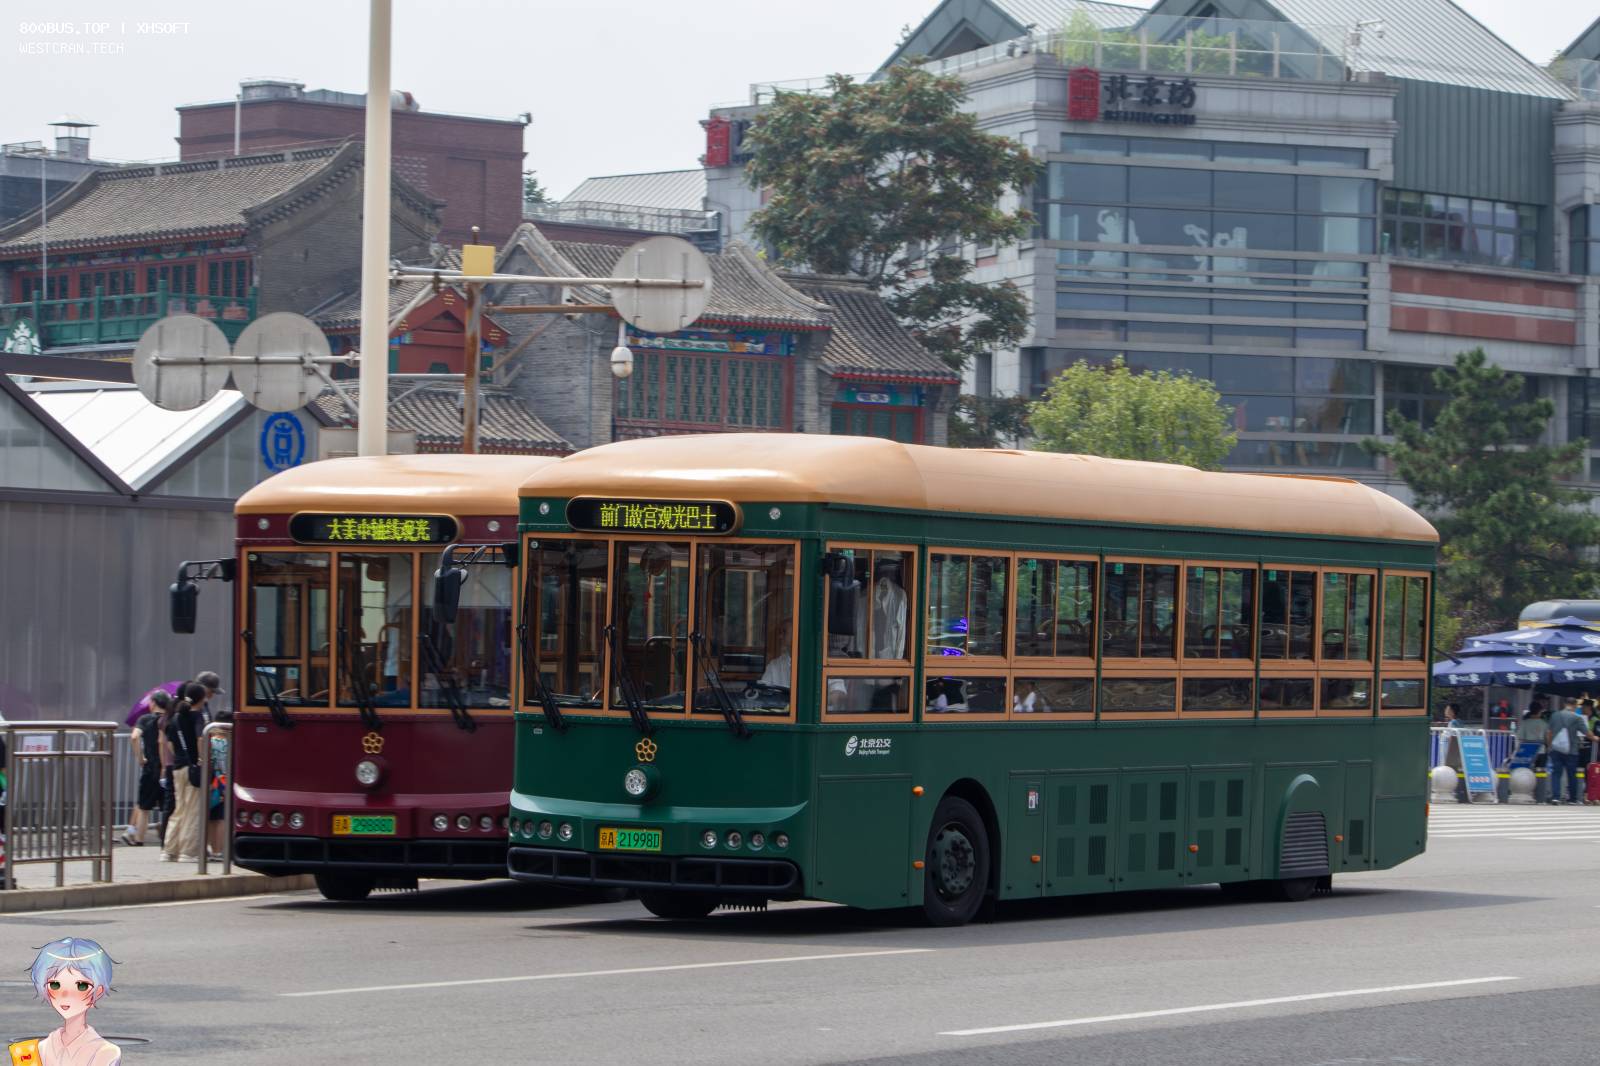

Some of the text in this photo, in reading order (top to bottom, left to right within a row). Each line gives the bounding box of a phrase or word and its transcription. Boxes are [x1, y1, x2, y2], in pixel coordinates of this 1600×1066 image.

[1104, 75, 1197, 109] 北京坊
[600, 503, 717, 530] 前门故宫观光巴士
[859, 738, 892, 748] 北京公交
